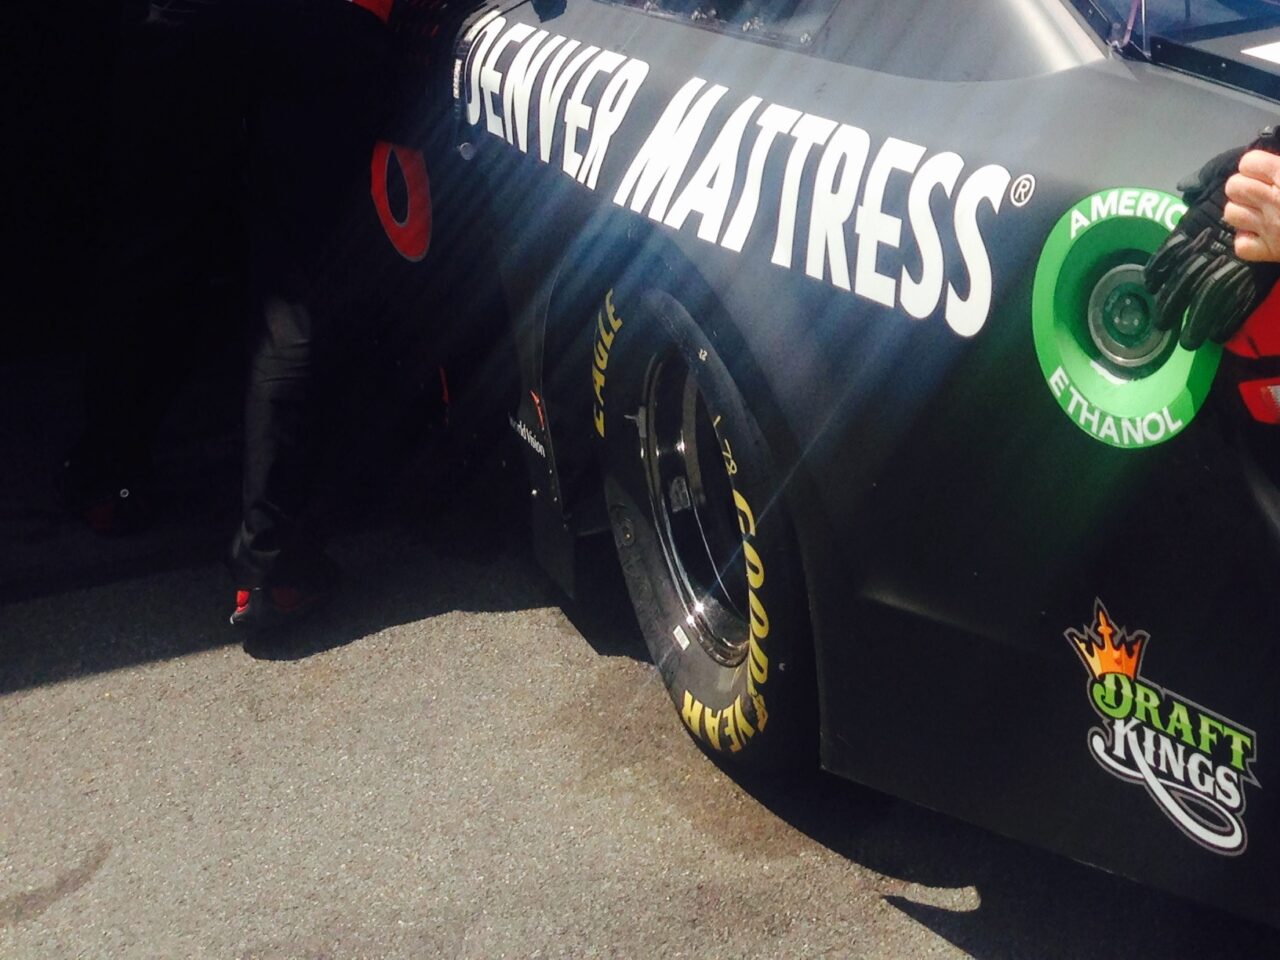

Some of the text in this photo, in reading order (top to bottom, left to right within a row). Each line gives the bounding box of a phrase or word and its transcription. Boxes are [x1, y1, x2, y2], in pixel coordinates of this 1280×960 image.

[463, 10, 650, 192] DENVER
[1069, 190, 1189, 240] AMERIC
[592, 287, 624, 439] EAGLE
[1048, 366, 1183, 445] ETHANOL
[1092, 672, 1252, 771] DRAFT
[1092, 716, 1243, 849] KINGS
